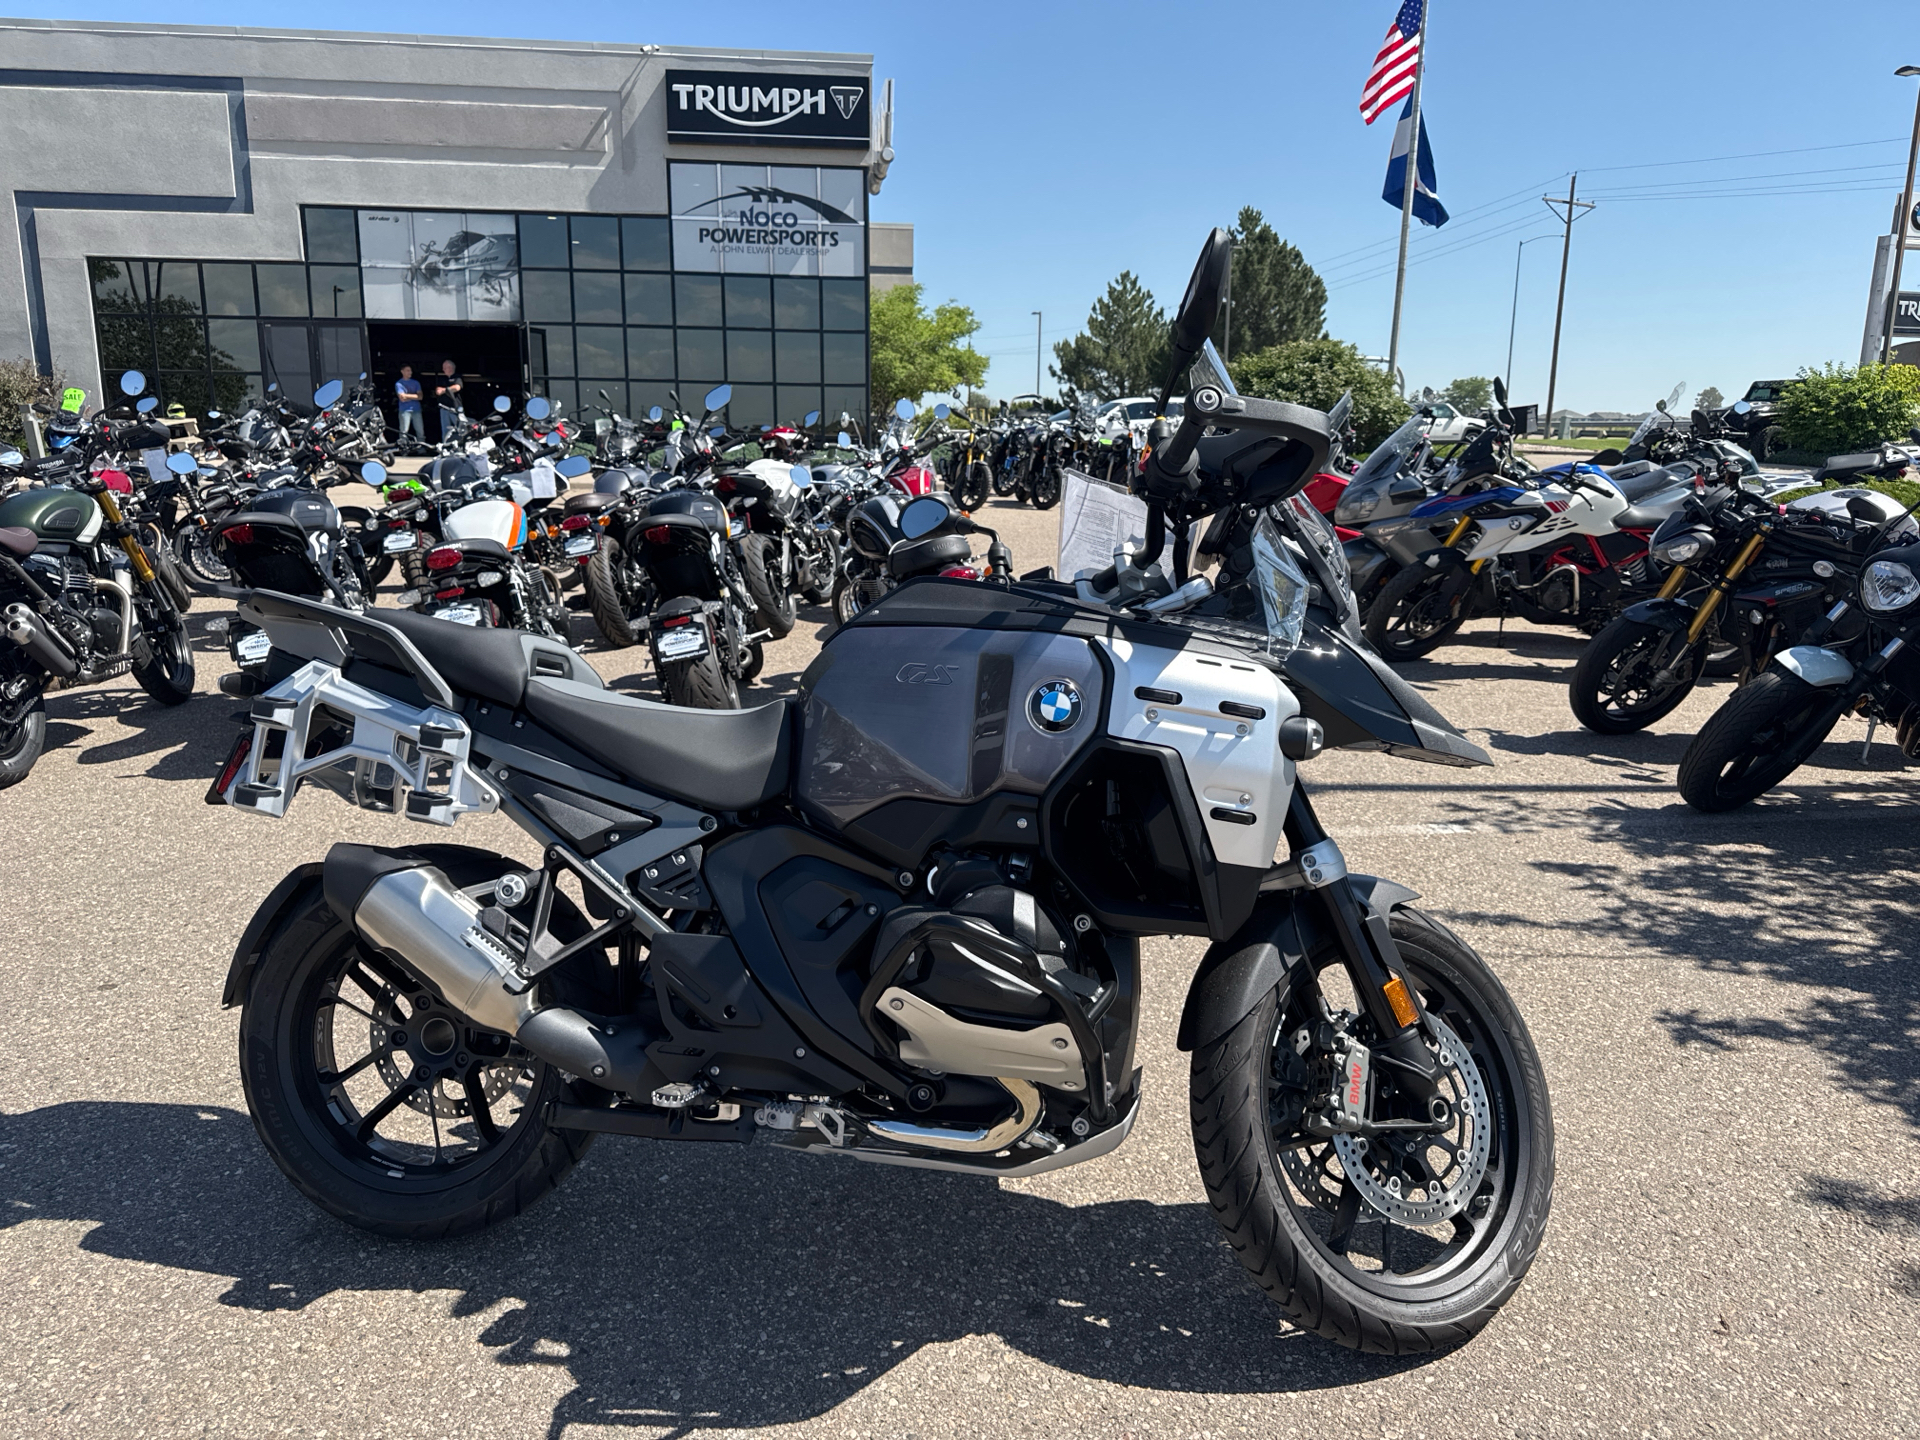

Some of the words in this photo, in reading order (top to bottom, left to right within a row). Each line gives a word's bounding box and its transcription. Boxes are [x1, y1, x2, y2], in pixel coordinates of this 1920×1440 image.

[672, 84, 826, 126] TRIUMPH
[740, 207, 798, 228] NOCO
[699, 228, 839, 247] POWERSPORTS
[710, 245, 717, 253] A
[720, 245, 745, 254] JOHN
[747, 246, 775, 255] ELWAY
[777, 248, 830, 257] DEALERSHIP
[64, 393, 82, 401] SALE
[1038, 683, 1079, 704] BMW
[1349, 1062, 1362, 1105] BMW
[1513, 1239, 1525, 1261] 2
